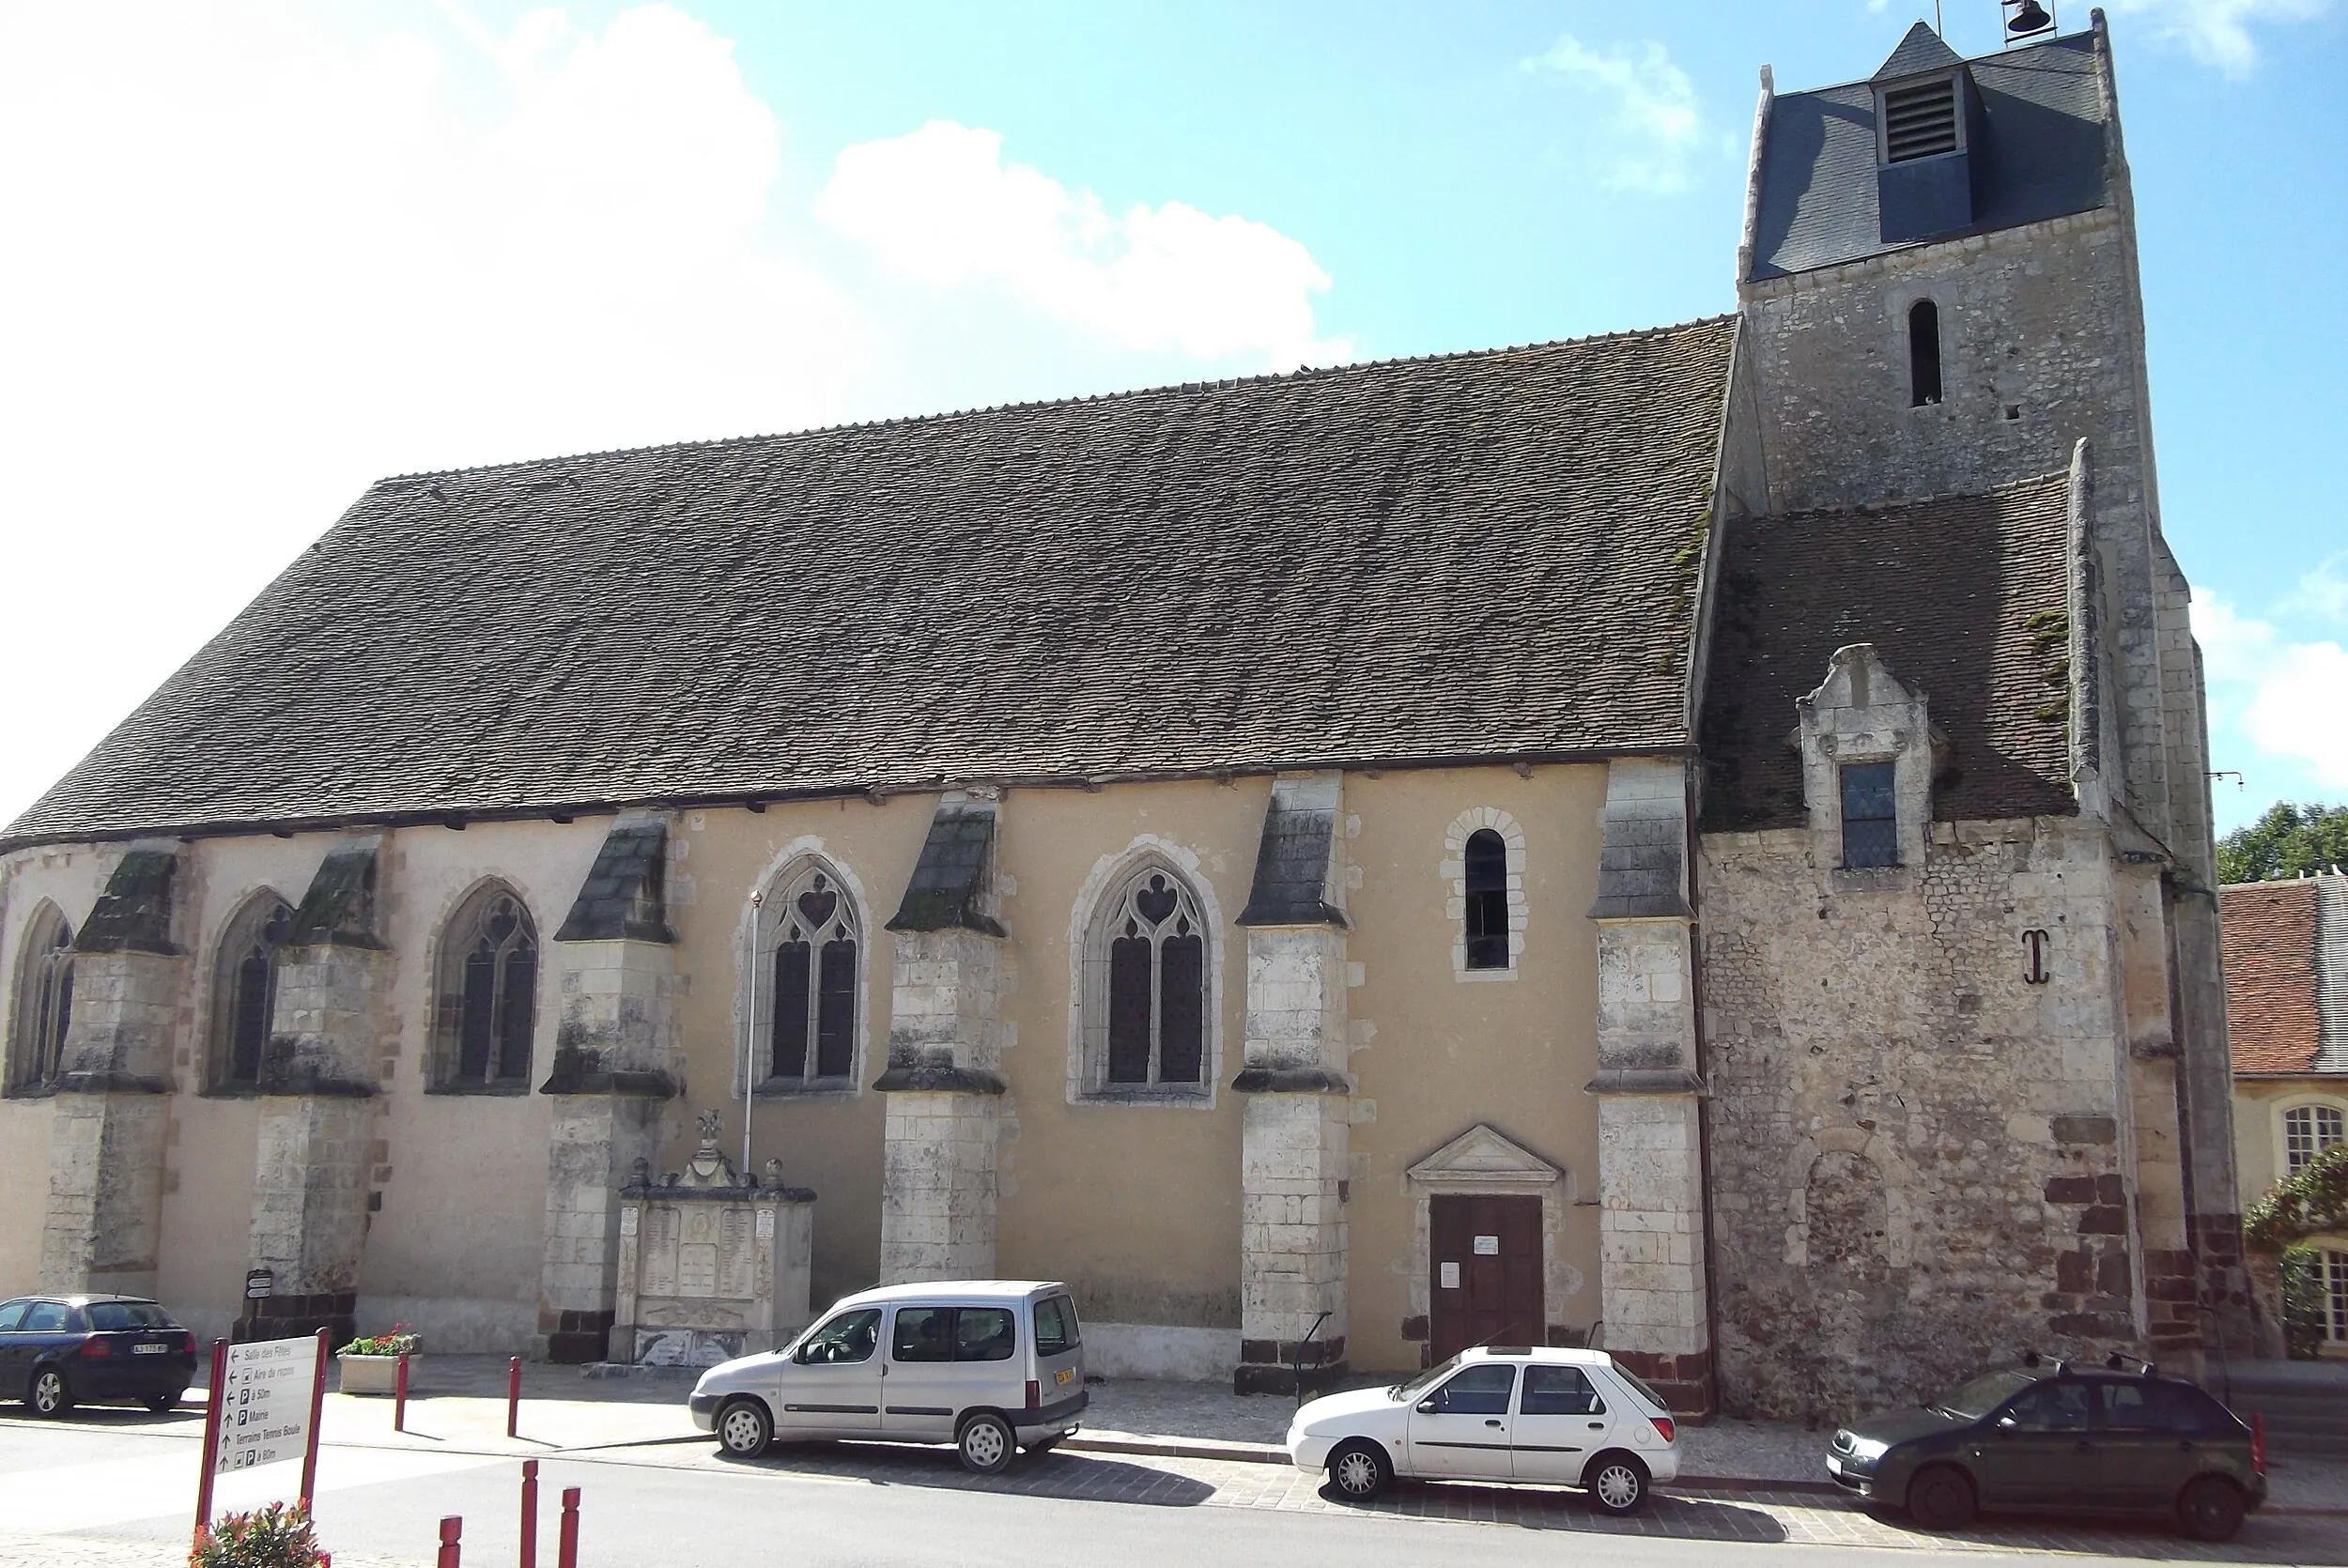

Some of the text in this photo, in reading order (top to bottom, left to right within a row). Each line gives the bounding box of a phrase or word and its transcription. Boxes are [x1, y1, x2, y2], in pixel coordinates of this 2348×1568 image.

[244, 1349, 260, 1360] Salle
[261, 1347, 273, 1359] des
[254, 1368, 267, 1380] Aire
[268, 1367, 276, 1378] de
[241, 1390, 249, 1404] P
[239, 1409, 269, 1425] P Mairie
[237, 1423, 301, 1445] Terrains Tennis Boule
[247, 1451, 255, 1465] P
